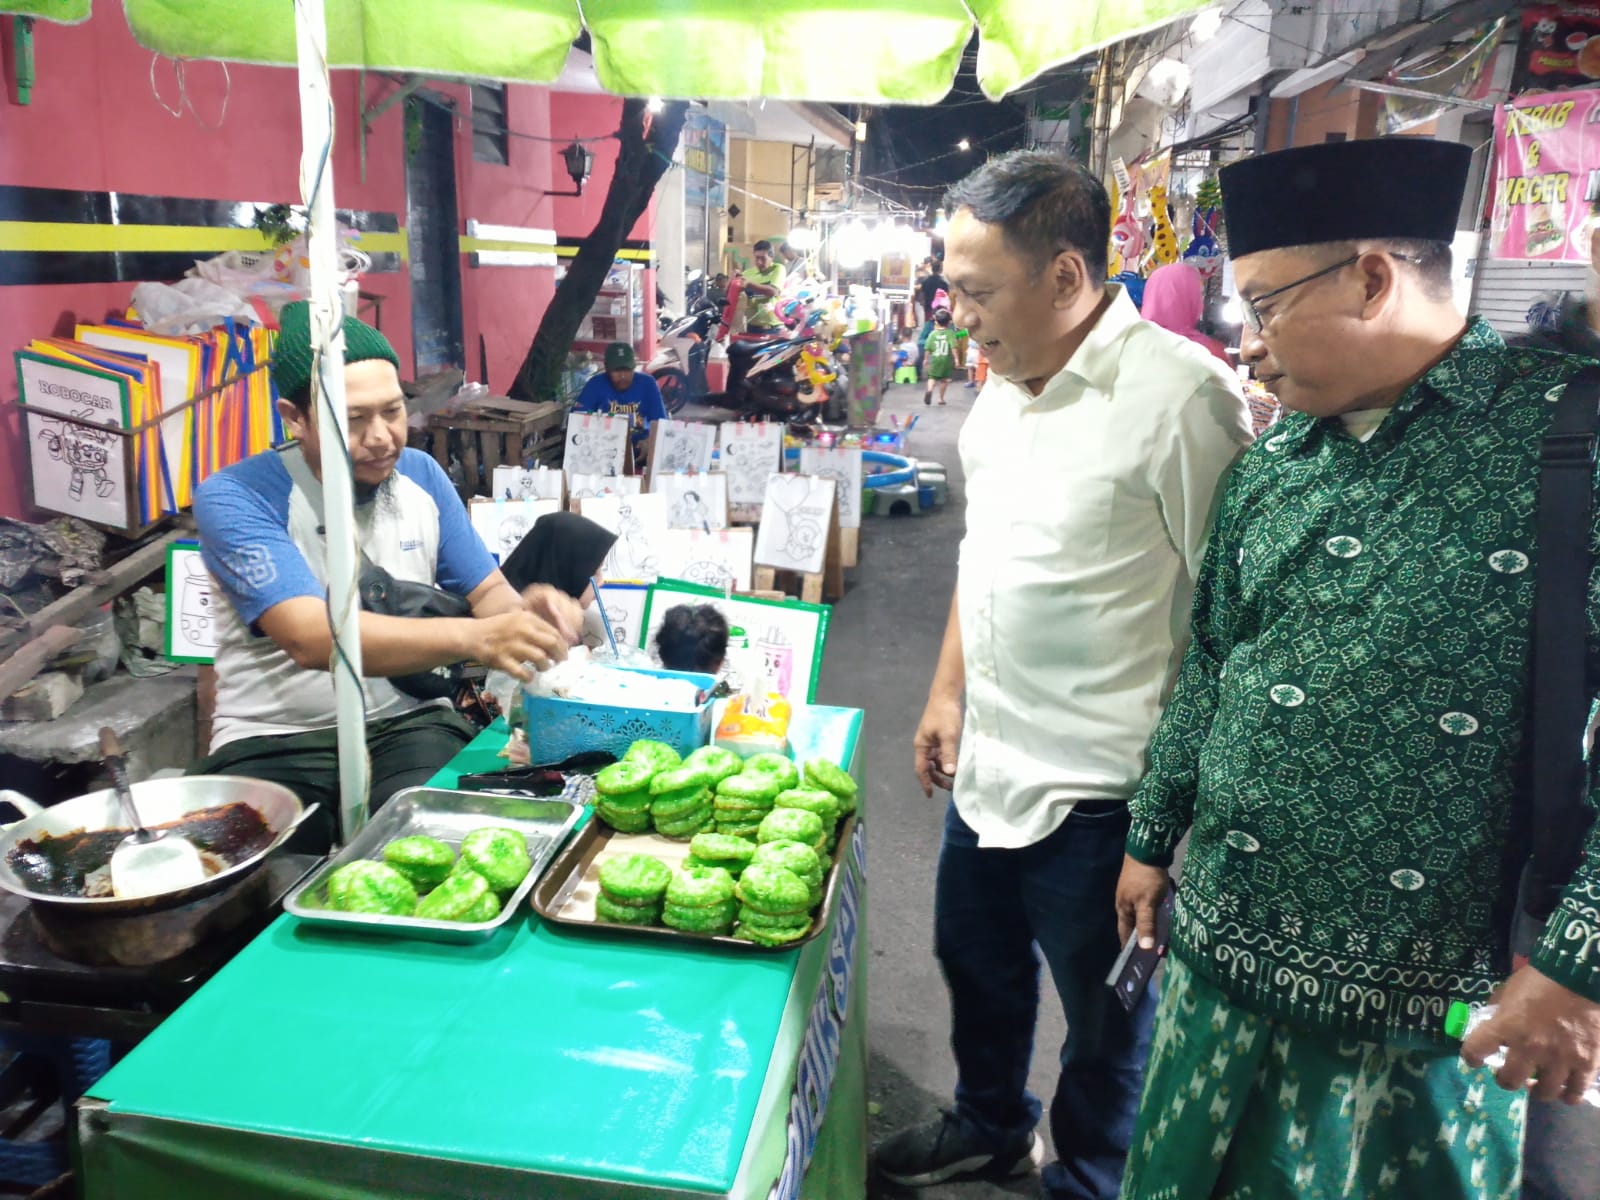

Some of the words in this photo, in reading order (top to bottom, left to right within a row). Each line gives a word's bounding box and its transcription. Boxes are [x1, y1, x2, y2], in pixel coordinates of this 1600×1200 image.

[1506, 100, 1575, 138] KEBAB
[1527, 140, 1540, 168] &
[38, 379, 113, 410] ROBOCAR
